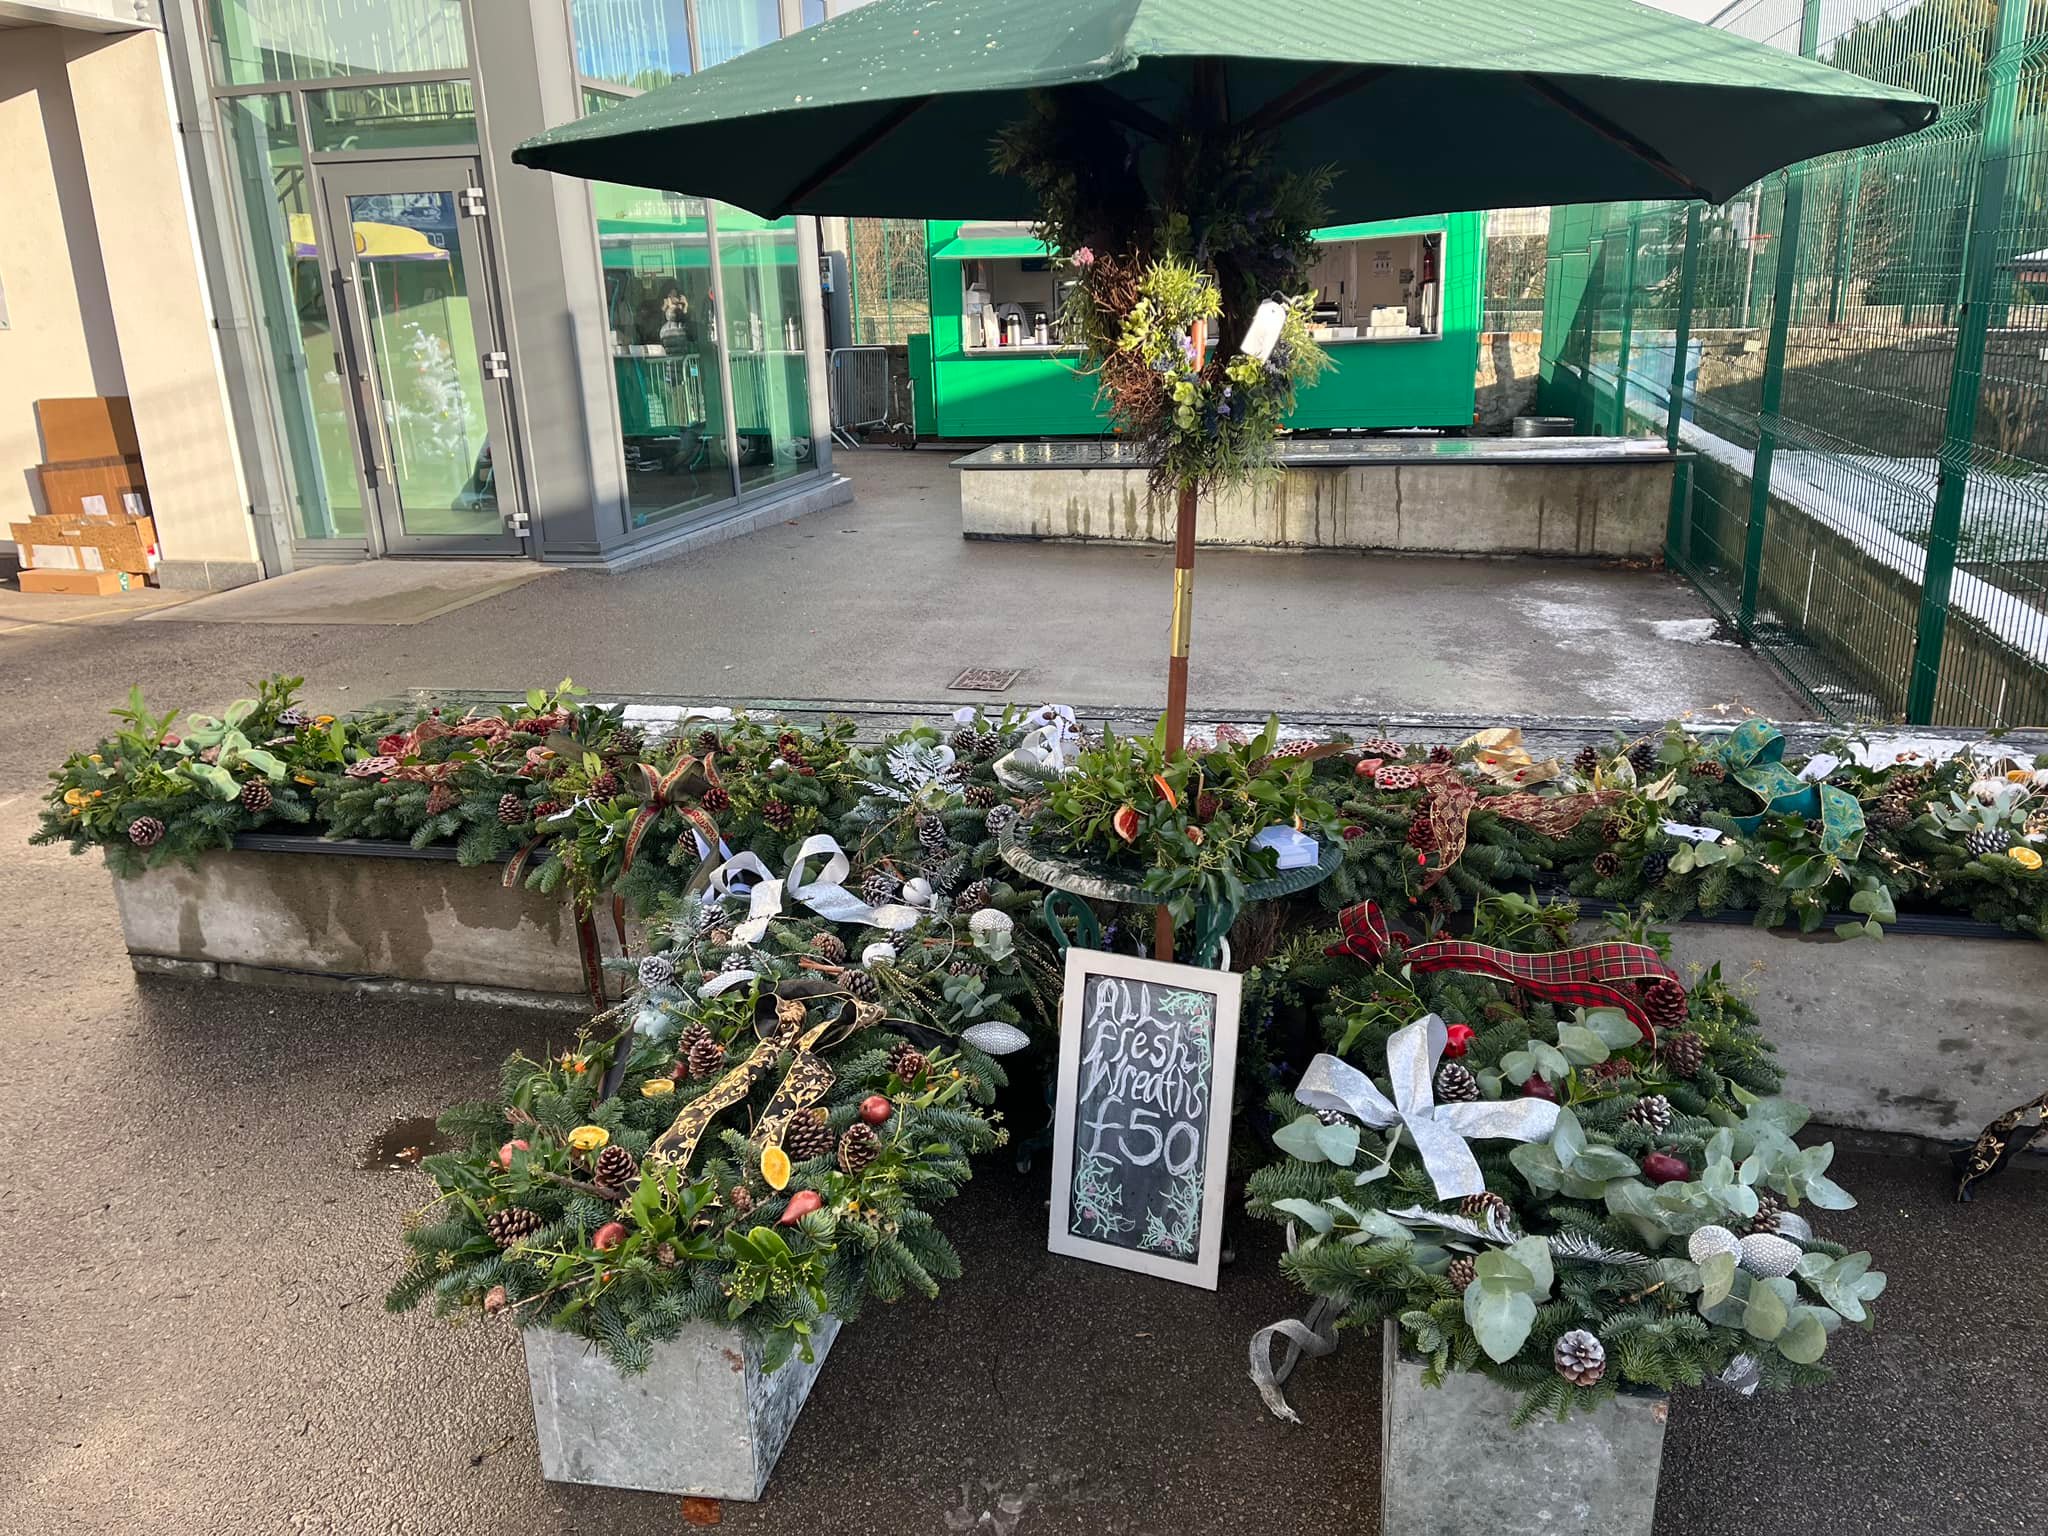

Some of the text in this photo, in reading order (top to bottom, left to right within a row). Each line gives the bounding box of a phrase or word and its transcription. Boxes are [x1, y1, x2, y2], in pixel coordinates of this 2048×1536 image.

[1088, 978, 1177, 1030] ALL
[1083, 1019, 1198, 1074] Fresh
[1081, 1051, 1202, 1118] Wreaths
[1084, 1097, 1199, 1175] £50
